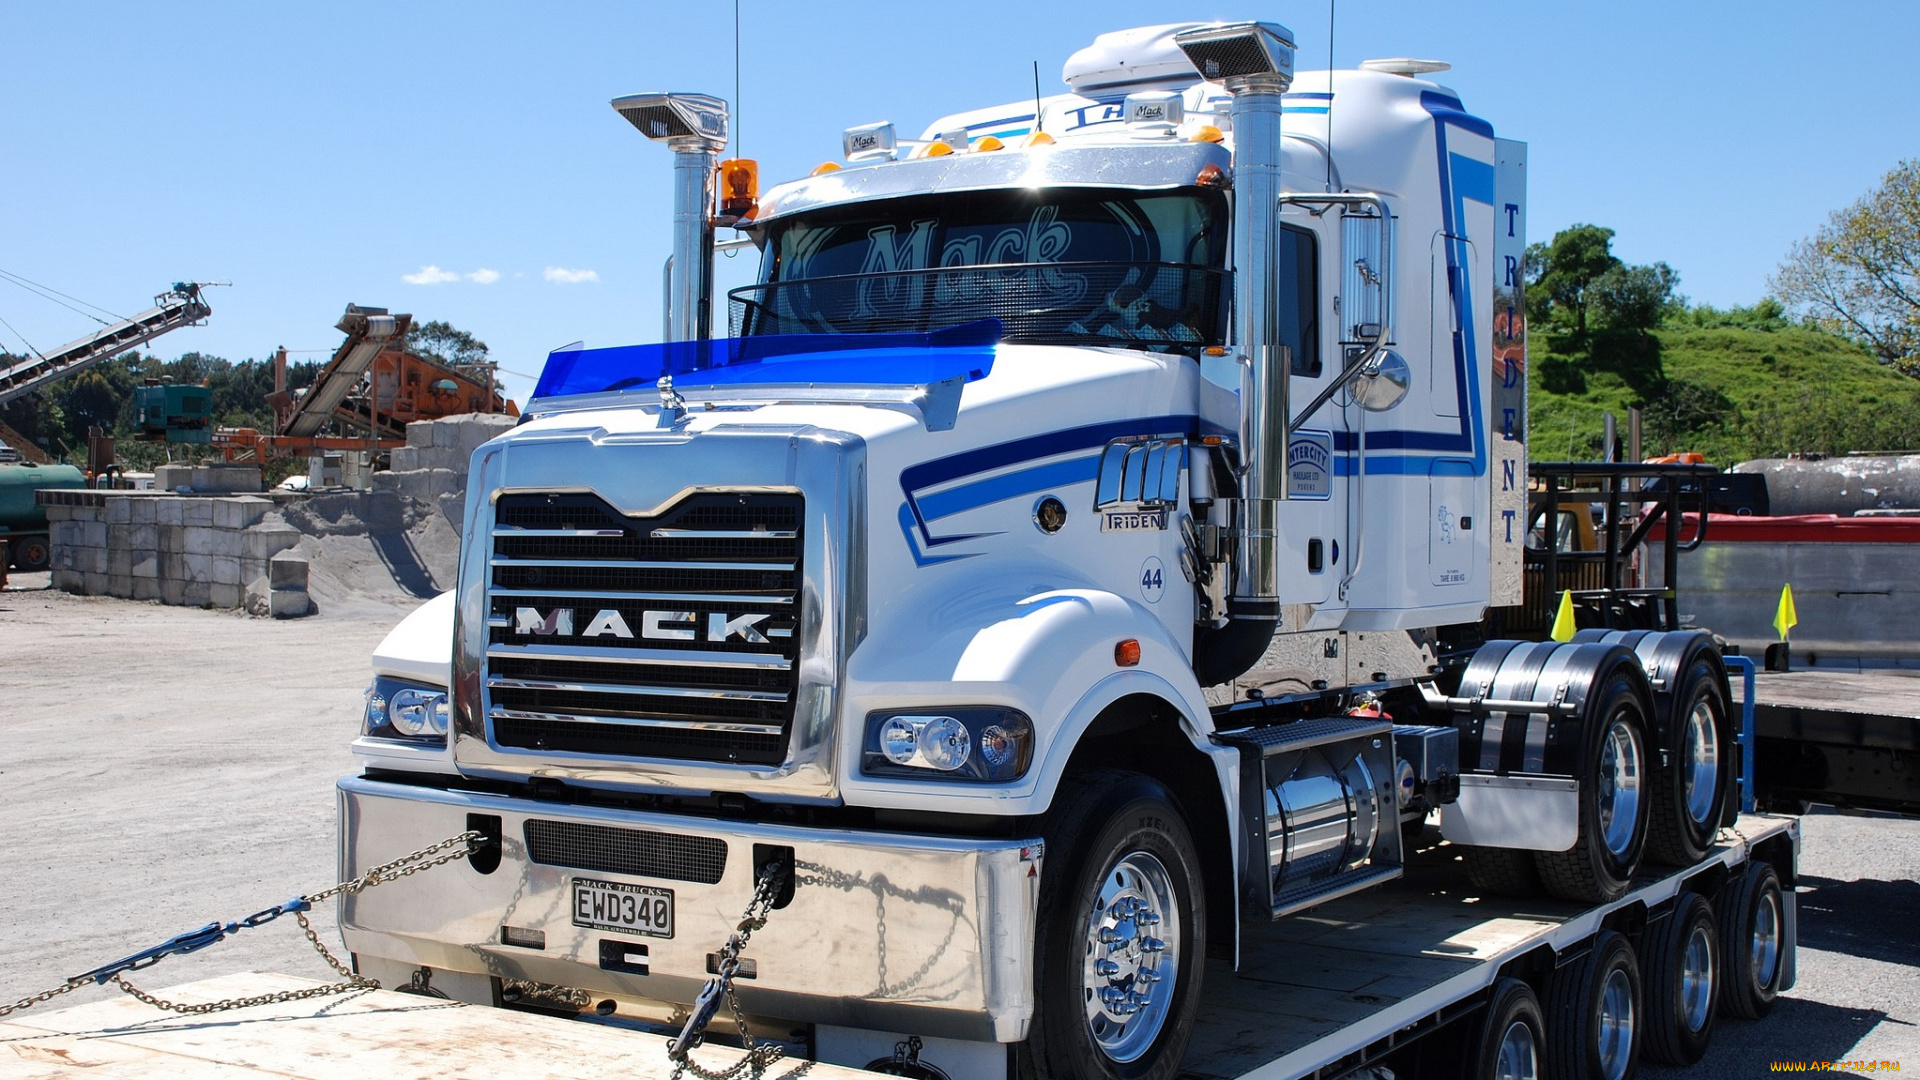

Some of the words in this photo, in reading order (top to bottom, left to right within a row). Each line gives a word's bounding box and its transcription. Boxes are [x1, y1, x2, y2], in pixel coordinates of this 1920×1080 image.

[1137, 105, 1163, 118] Mack
[853, 134, 876, 148] Mack
[848, 204, 1089, 323] Mack
[1502, 203, 1519, 544] TRIDENT
[1289, 446, 1327, 467] NTERCITY
[1105, 510, 1167, 530] TRIDENT
[1142, 568, 1163, 590] 44
[515, 606, 771, 644] MACK
[581, 880, 613, 891] MACK
[618, 884, 663, 896] TRUCKS
[578, 888, 668, 929] EWD340
